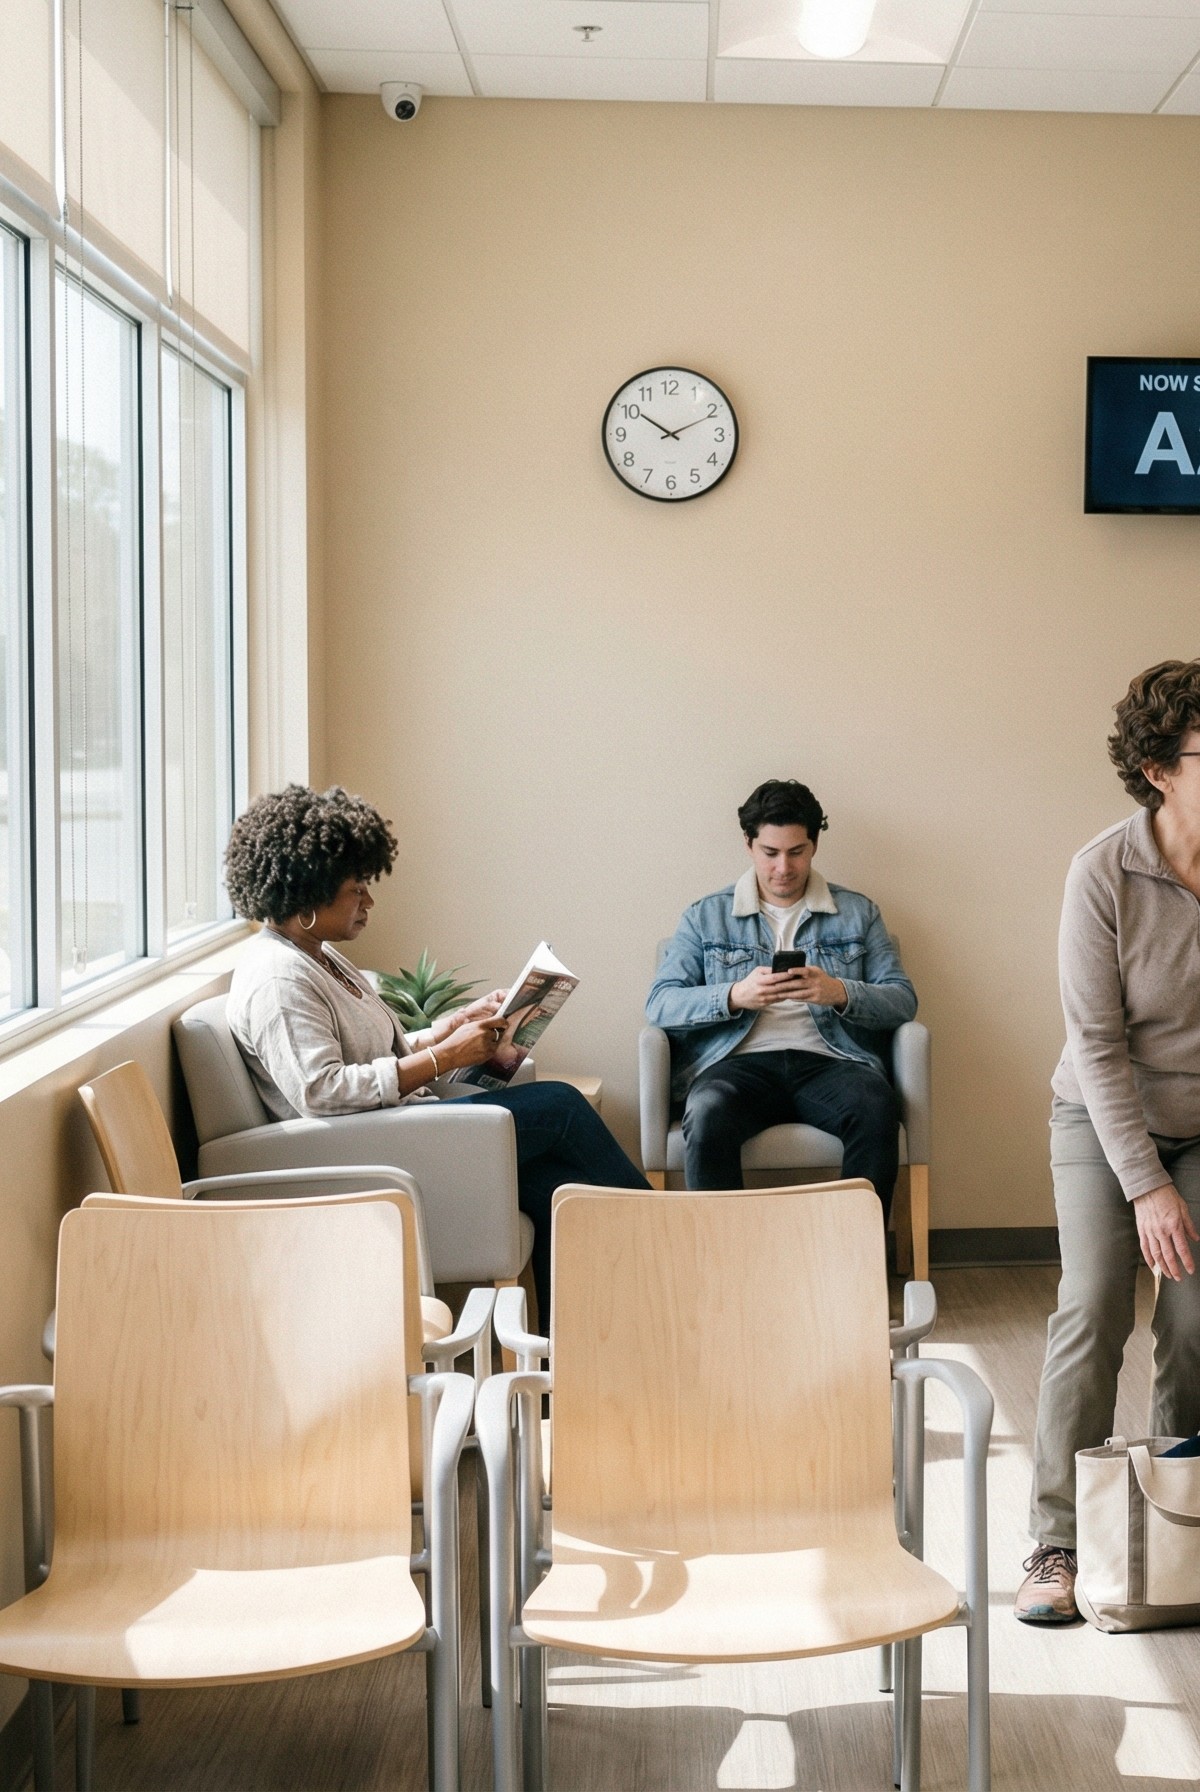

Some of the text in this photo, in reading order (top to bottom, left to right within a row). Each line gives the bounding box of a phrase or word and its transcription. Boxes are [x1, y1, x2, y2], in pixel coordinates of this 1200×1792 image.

[661, 380, 679, 395] 12
[1139, 374, 1188, 392] NOW
[638, 387, 652, 402] 11
[691, 386, 697, 400] 1
[621, 404, 640, 419] 10
[707, 403, 718, 418] 2
[615, 427, 626, 442] 9
[714, 427, 725, 442] 3
[623, 451, 635, 467] 8
[706, 452, 718, 466] 4
[643, 469, 653, 483] 7
[666, 475, 677, 490] 6
[690, 469, 700, 483] 5
